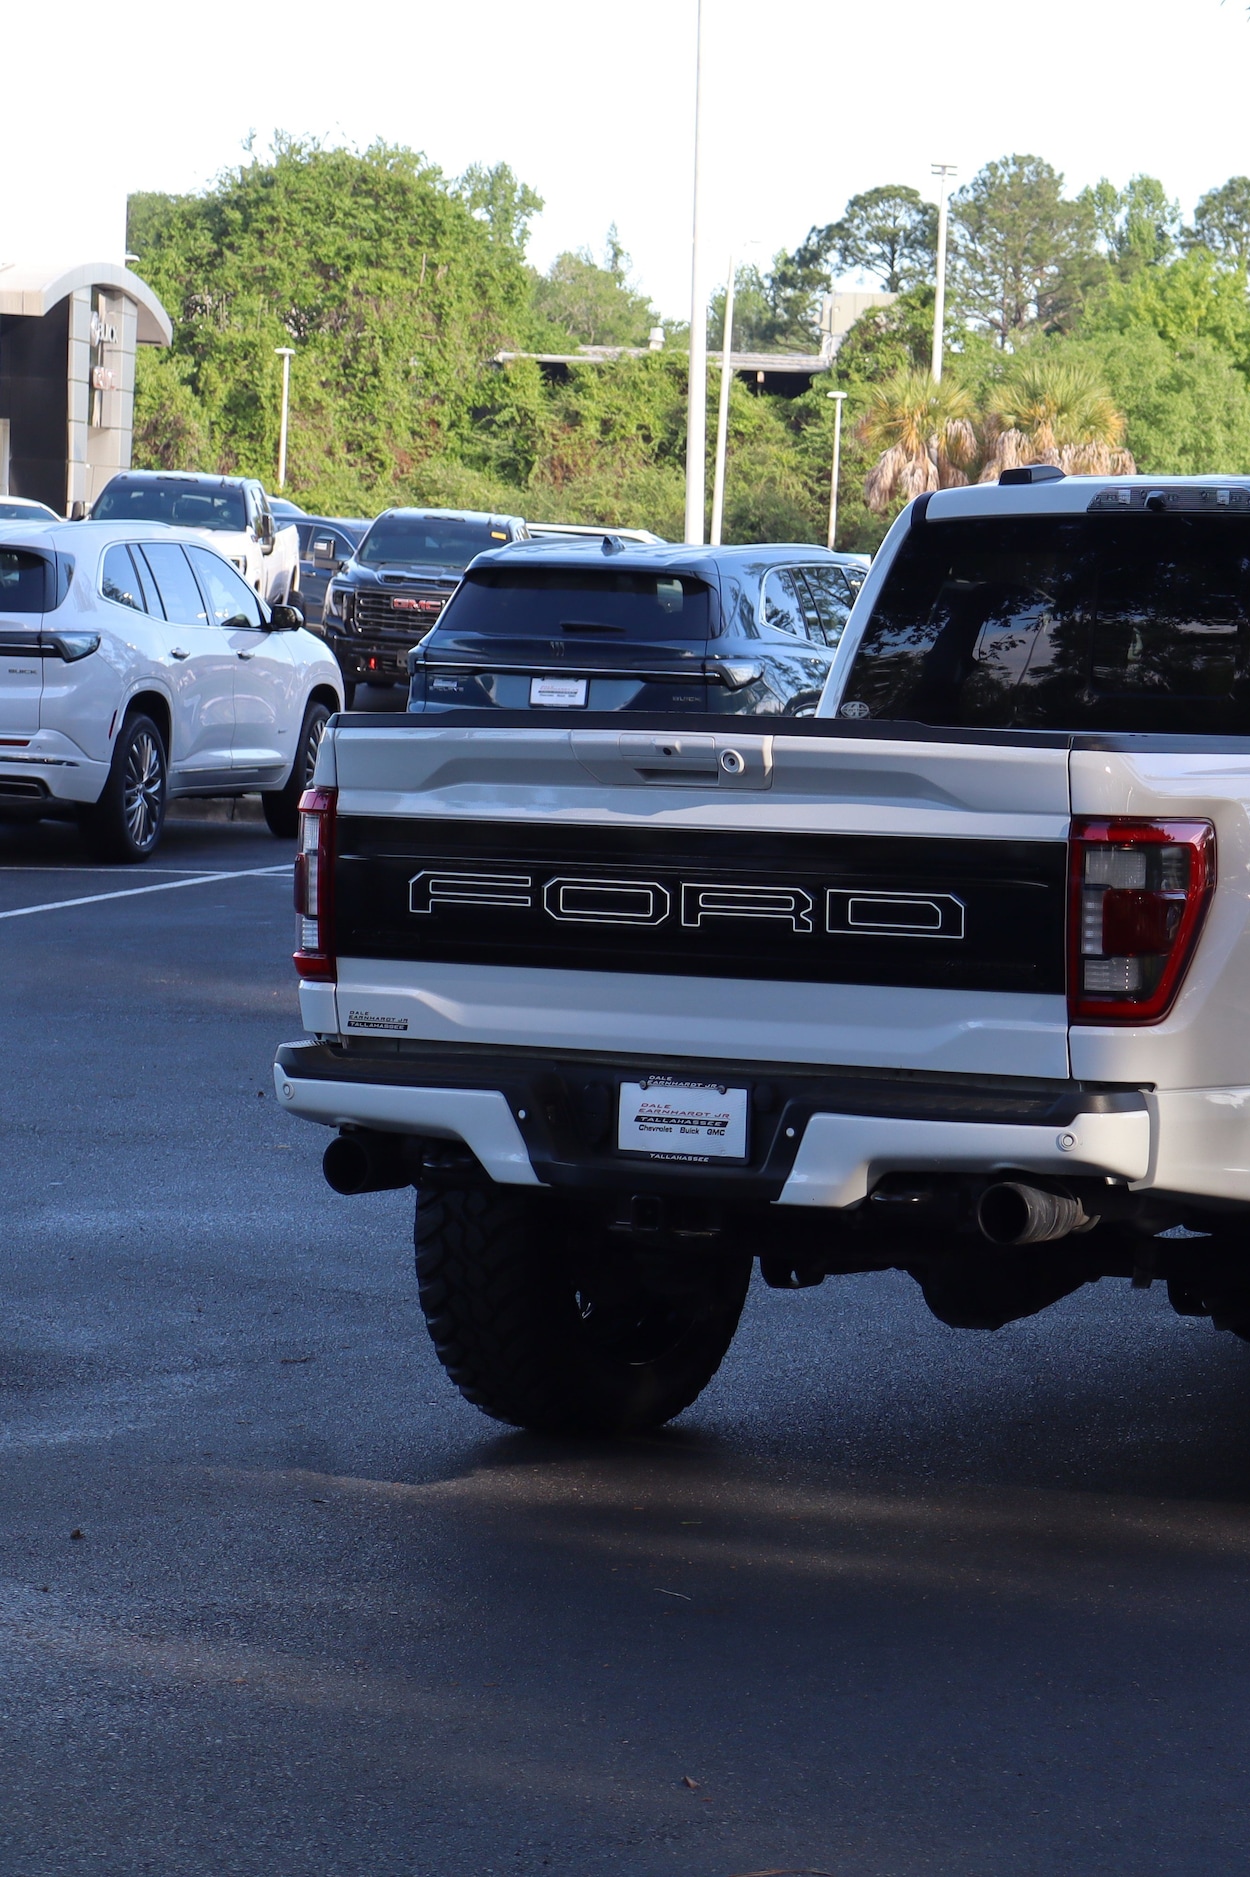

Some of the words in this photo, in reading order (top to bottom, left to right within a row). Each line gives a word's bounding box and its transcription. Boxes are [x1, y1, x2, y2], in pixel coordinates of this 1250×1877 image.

[393, 598, 441, 611] GMC
[409, 869, 965, 939] FORD
[348, 1014, 396, 1022] EARNHARDT
[350, 1021, 405, 1030] TALLAHASSEE
[647, 1080, 703, 1088] EARNHARDT
[638, 1108, 711, 1117] EARNHARDT
[640, 1116, 723, 1127] TALLAHASSEE
[638, 1124, 673, 1133] Chevrolet
[679, 1126, 700, 1135] Buick
[706, 1128, 726, 1136] GMC
[649, 1153, 710, 1163] TALLAHASSEE
